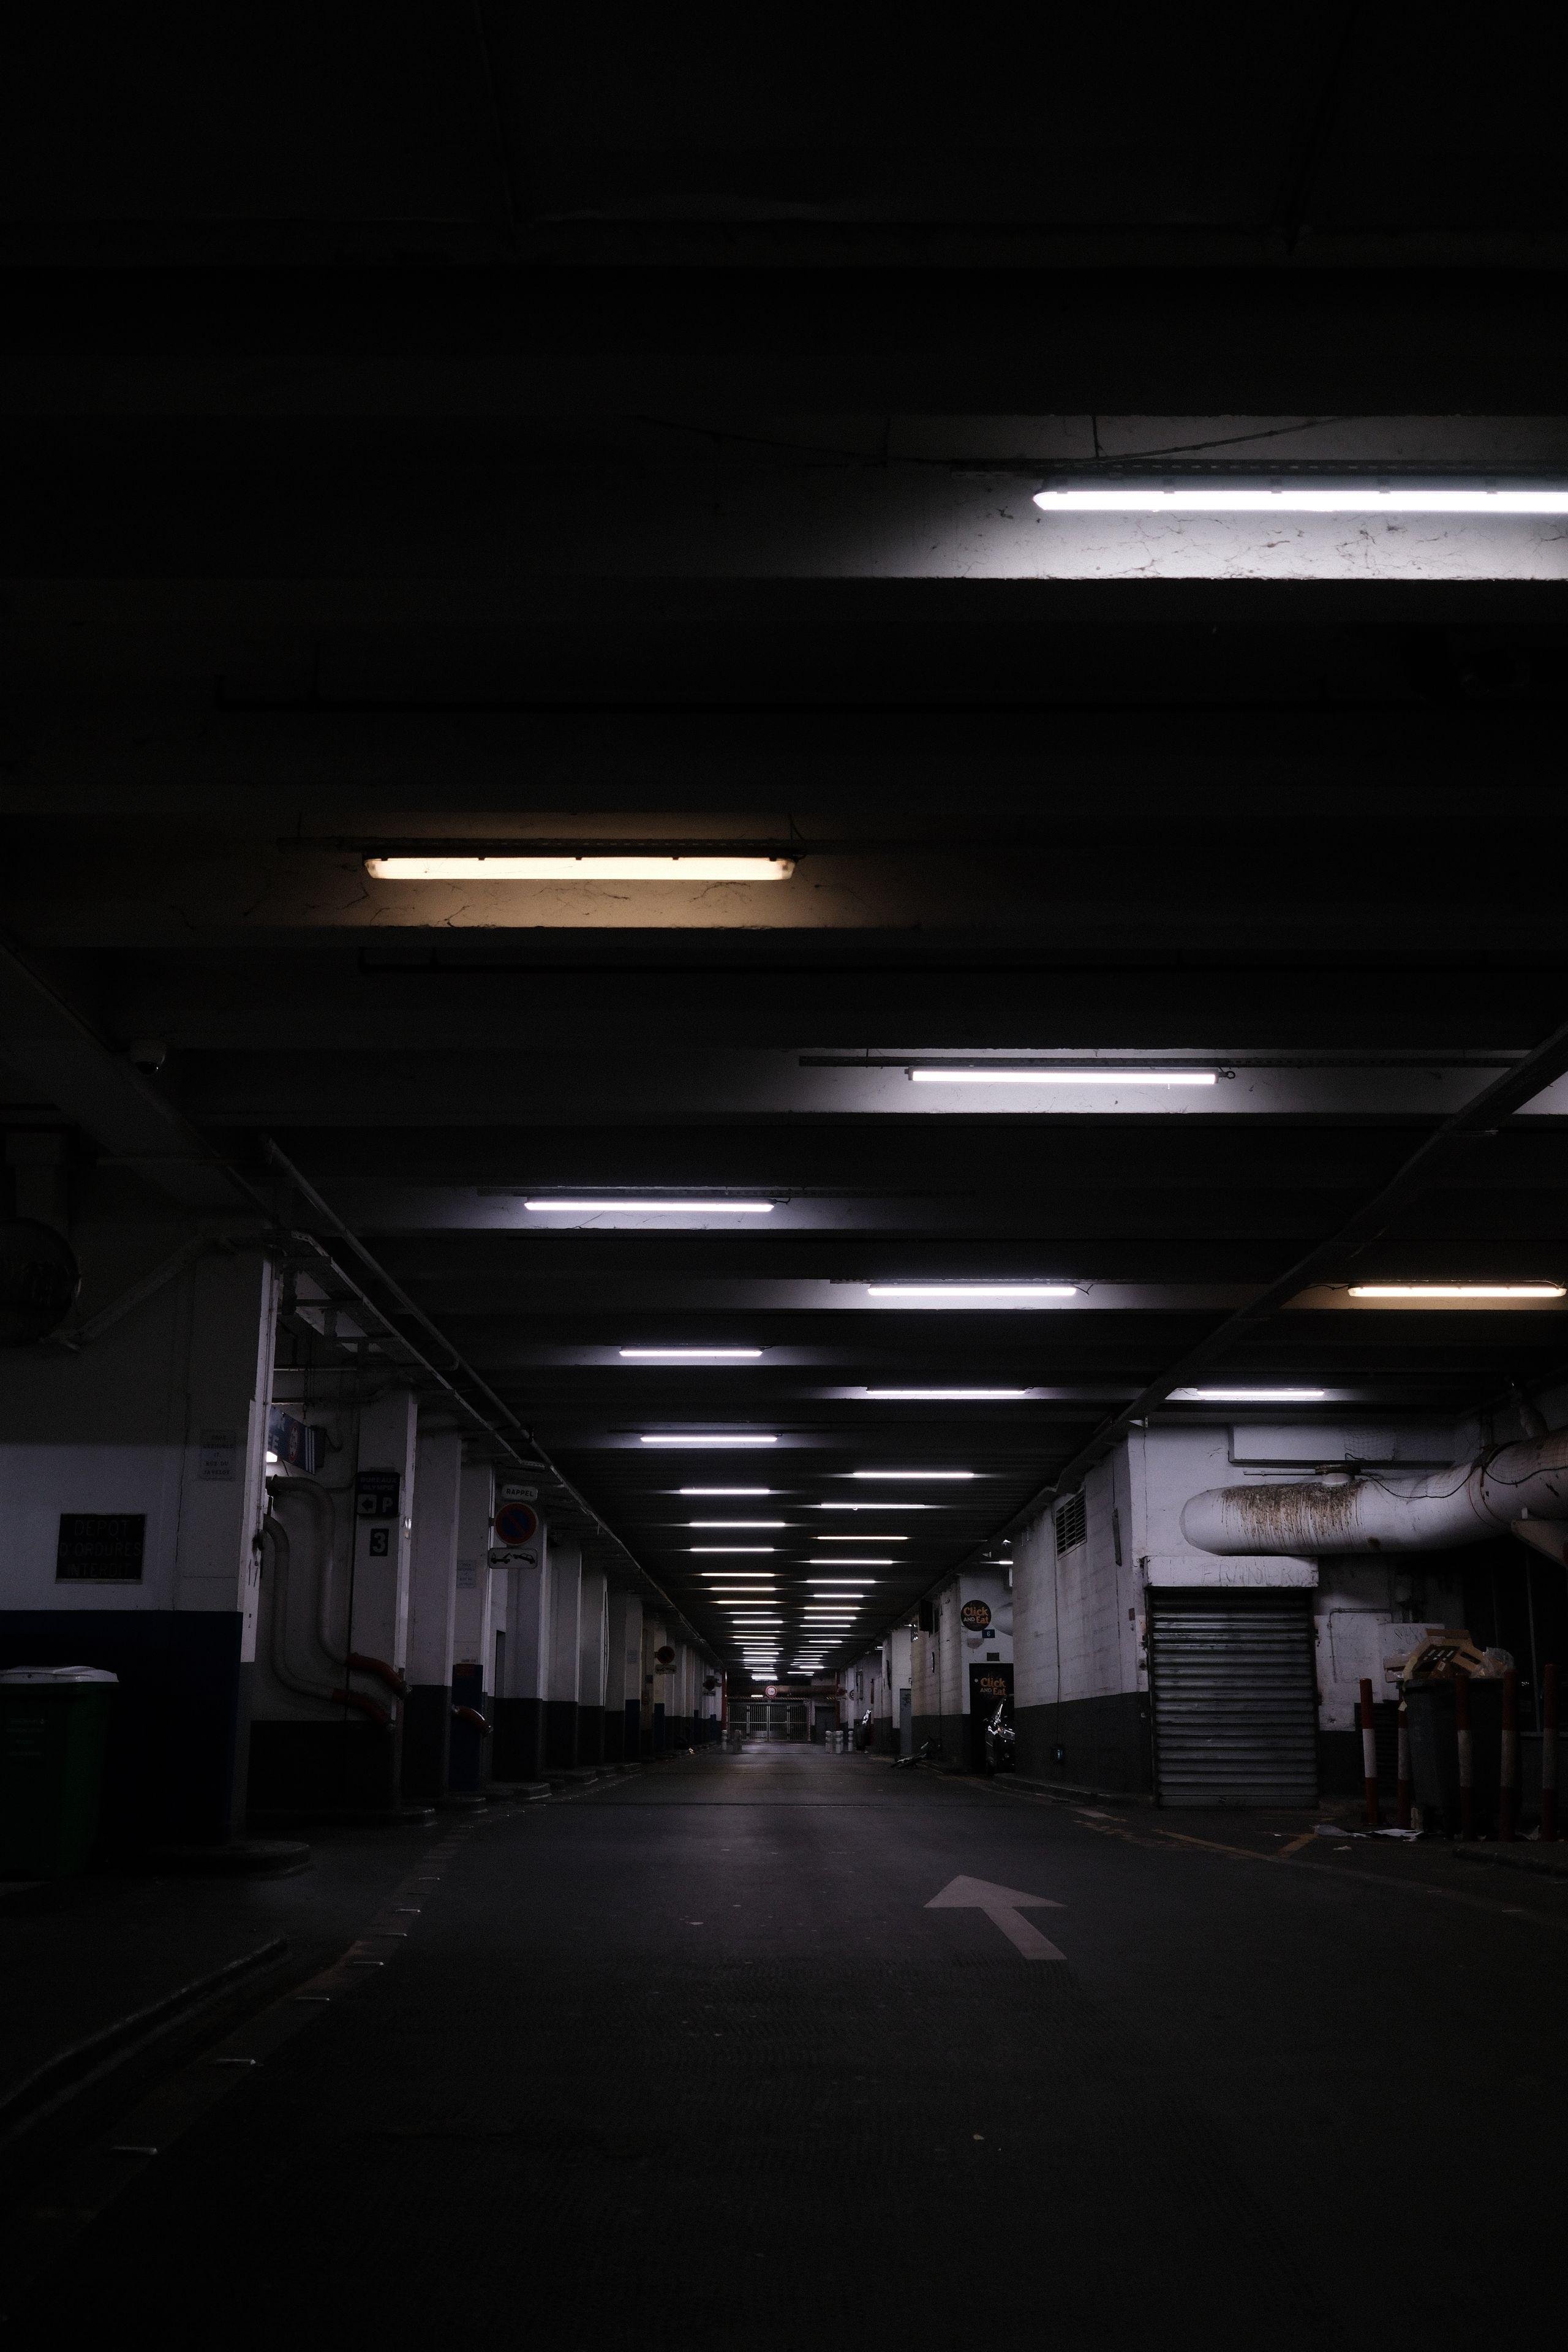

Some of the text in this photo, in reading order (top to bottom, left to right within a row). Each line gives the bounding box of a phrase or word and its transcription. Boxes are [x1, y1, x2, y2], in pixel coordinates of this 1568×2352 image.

[506, 1488, 533, 1497] RAPPEL
[382, 1497, 393, 1513] P
[74, 1519, 130, 1536] DEPOT
[59, 1542, 141, 1557] D'ORDURES
[372, 1532, 386, 1553] 3
[67, 1562, 133, 1578] INTERDIT
[963, 1606, 989, 1616] Click
[980, 1677, 1006, 1687] Click
[993, 1687, 1006, 1695] Eat
